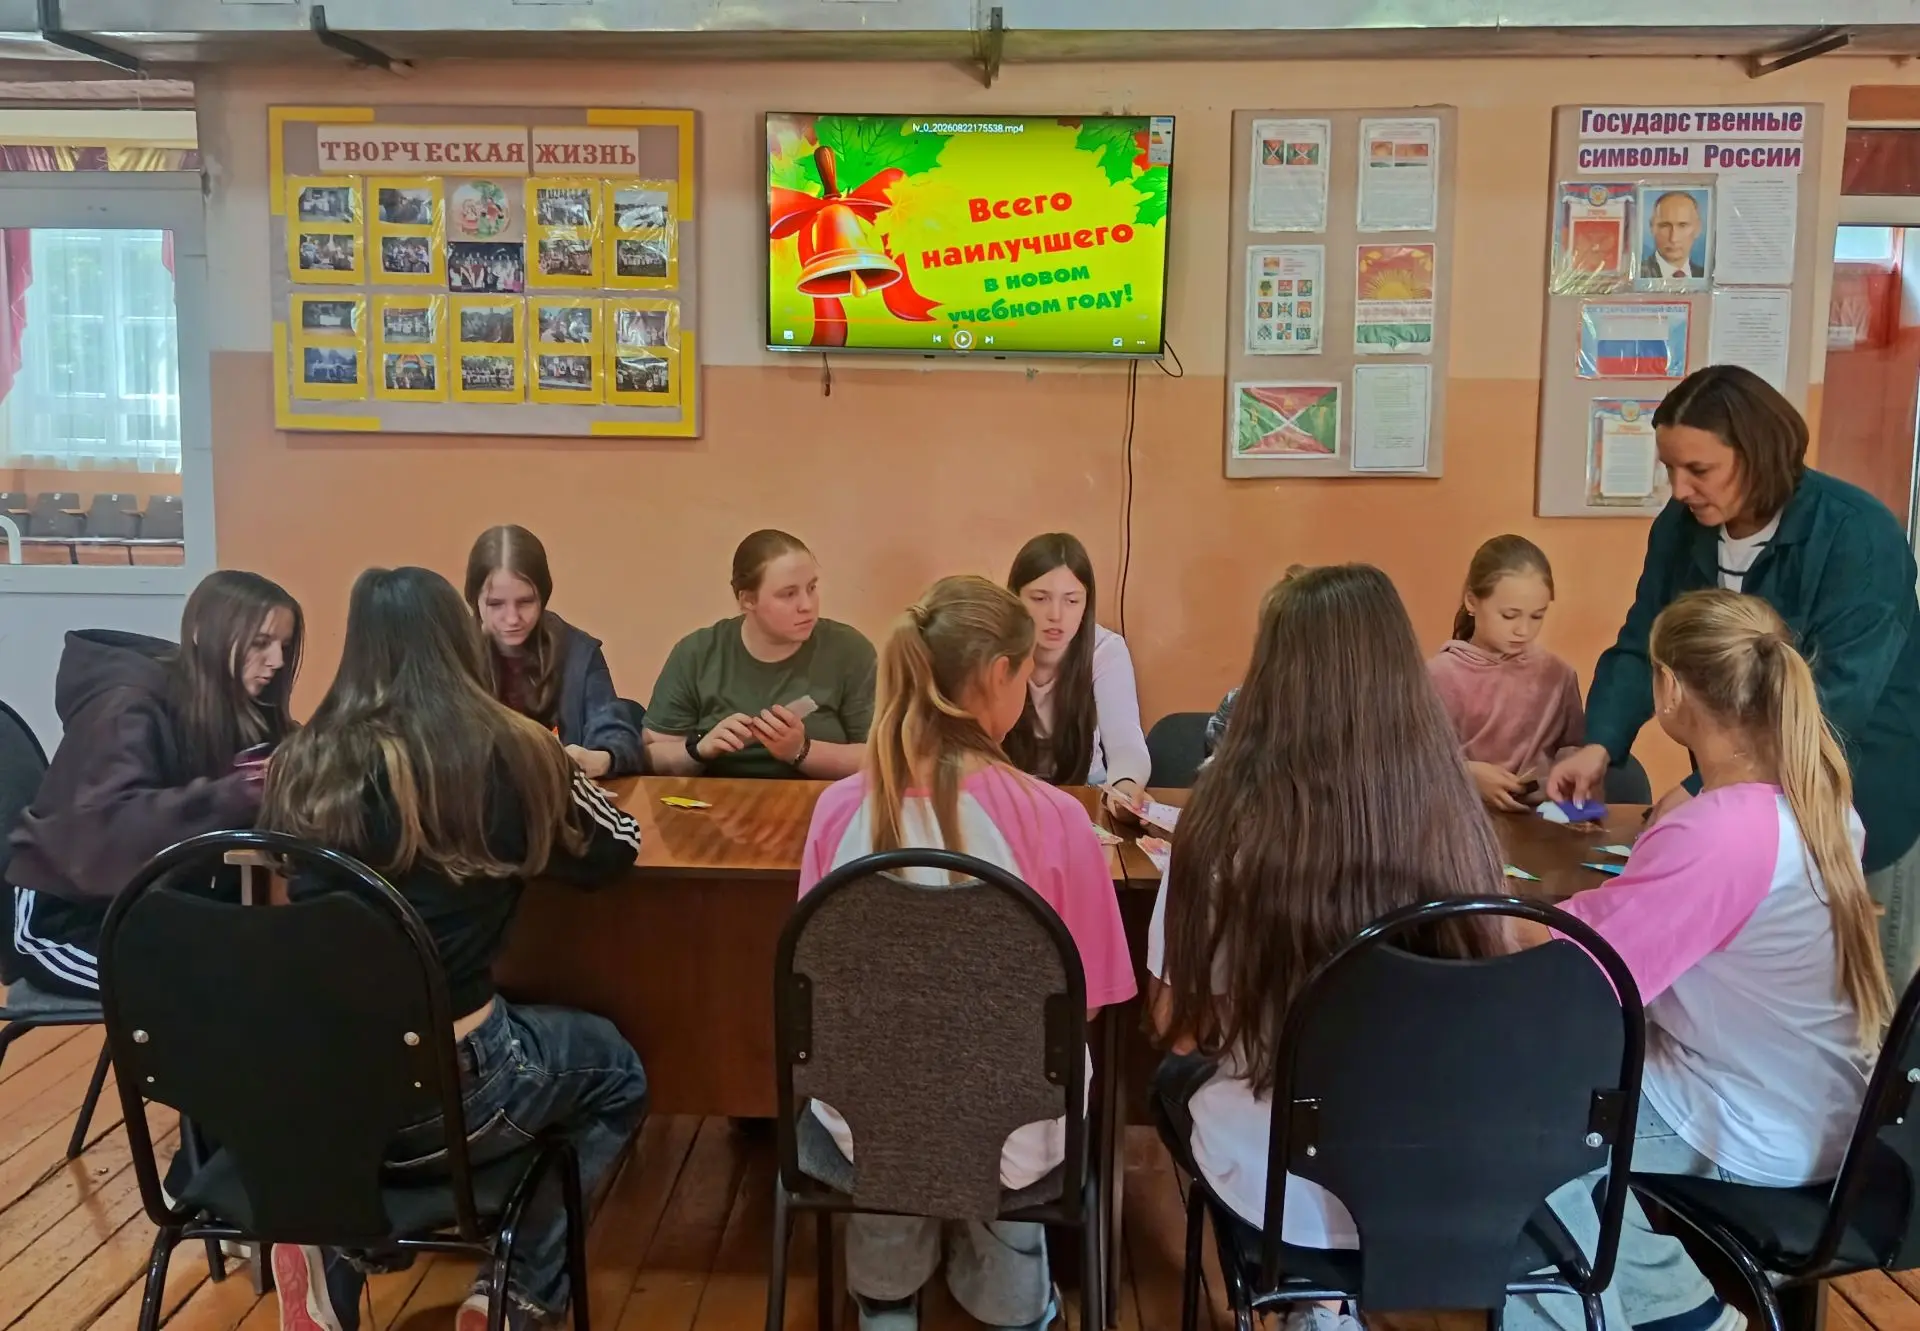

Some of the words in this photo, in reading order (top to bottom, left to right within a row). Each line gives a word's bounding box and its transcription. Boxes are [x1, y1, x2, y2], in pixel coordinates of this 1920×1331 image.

[320, 141, 525, 163] ТВОРЧЕСКАЯ
[535, 143, 637, 165] ЖИЗНЬ
[1579, 146, 1689, 168] символы
[1703, 144, 1801, 168] России
[968, 192, 1073, 223] Всего
[921, 223, 1134, 269] наилучшего
[983, 278, 999, 293] в
[1006, 265, 1090, 290] новом
[947, 298, 1061, 329] учебном
[1067, 283, 1134, 310] году!
